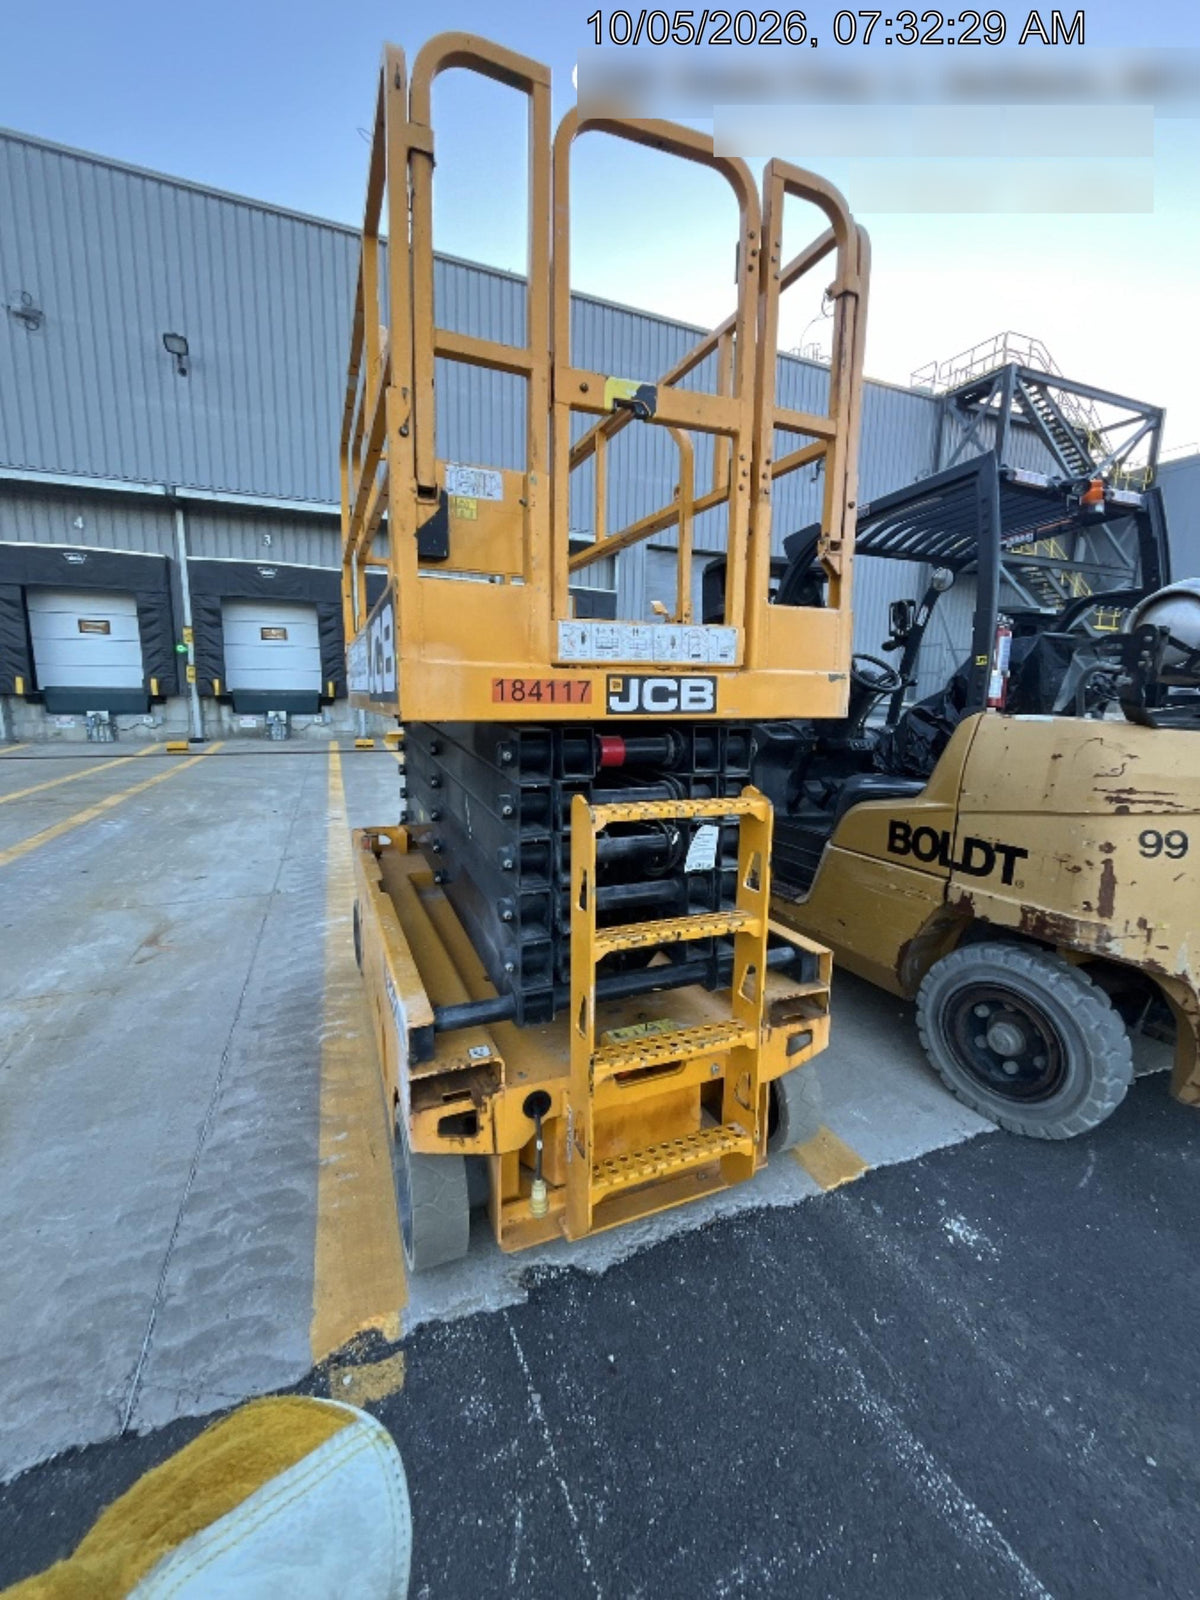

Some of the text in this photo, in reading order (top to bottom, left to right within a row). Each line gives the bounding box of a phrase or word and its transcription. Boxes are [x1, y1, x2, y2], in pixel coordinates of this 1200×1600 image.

[73, 515, 84, 529] 4
[263, 534, 271, 546] 3
[495, 679, 591, 702] 184117
[609, 678, 713, 712] JCB
[887, 819, 1029, 886] BOLDT
[1138, 829, 1189, 860] 99
